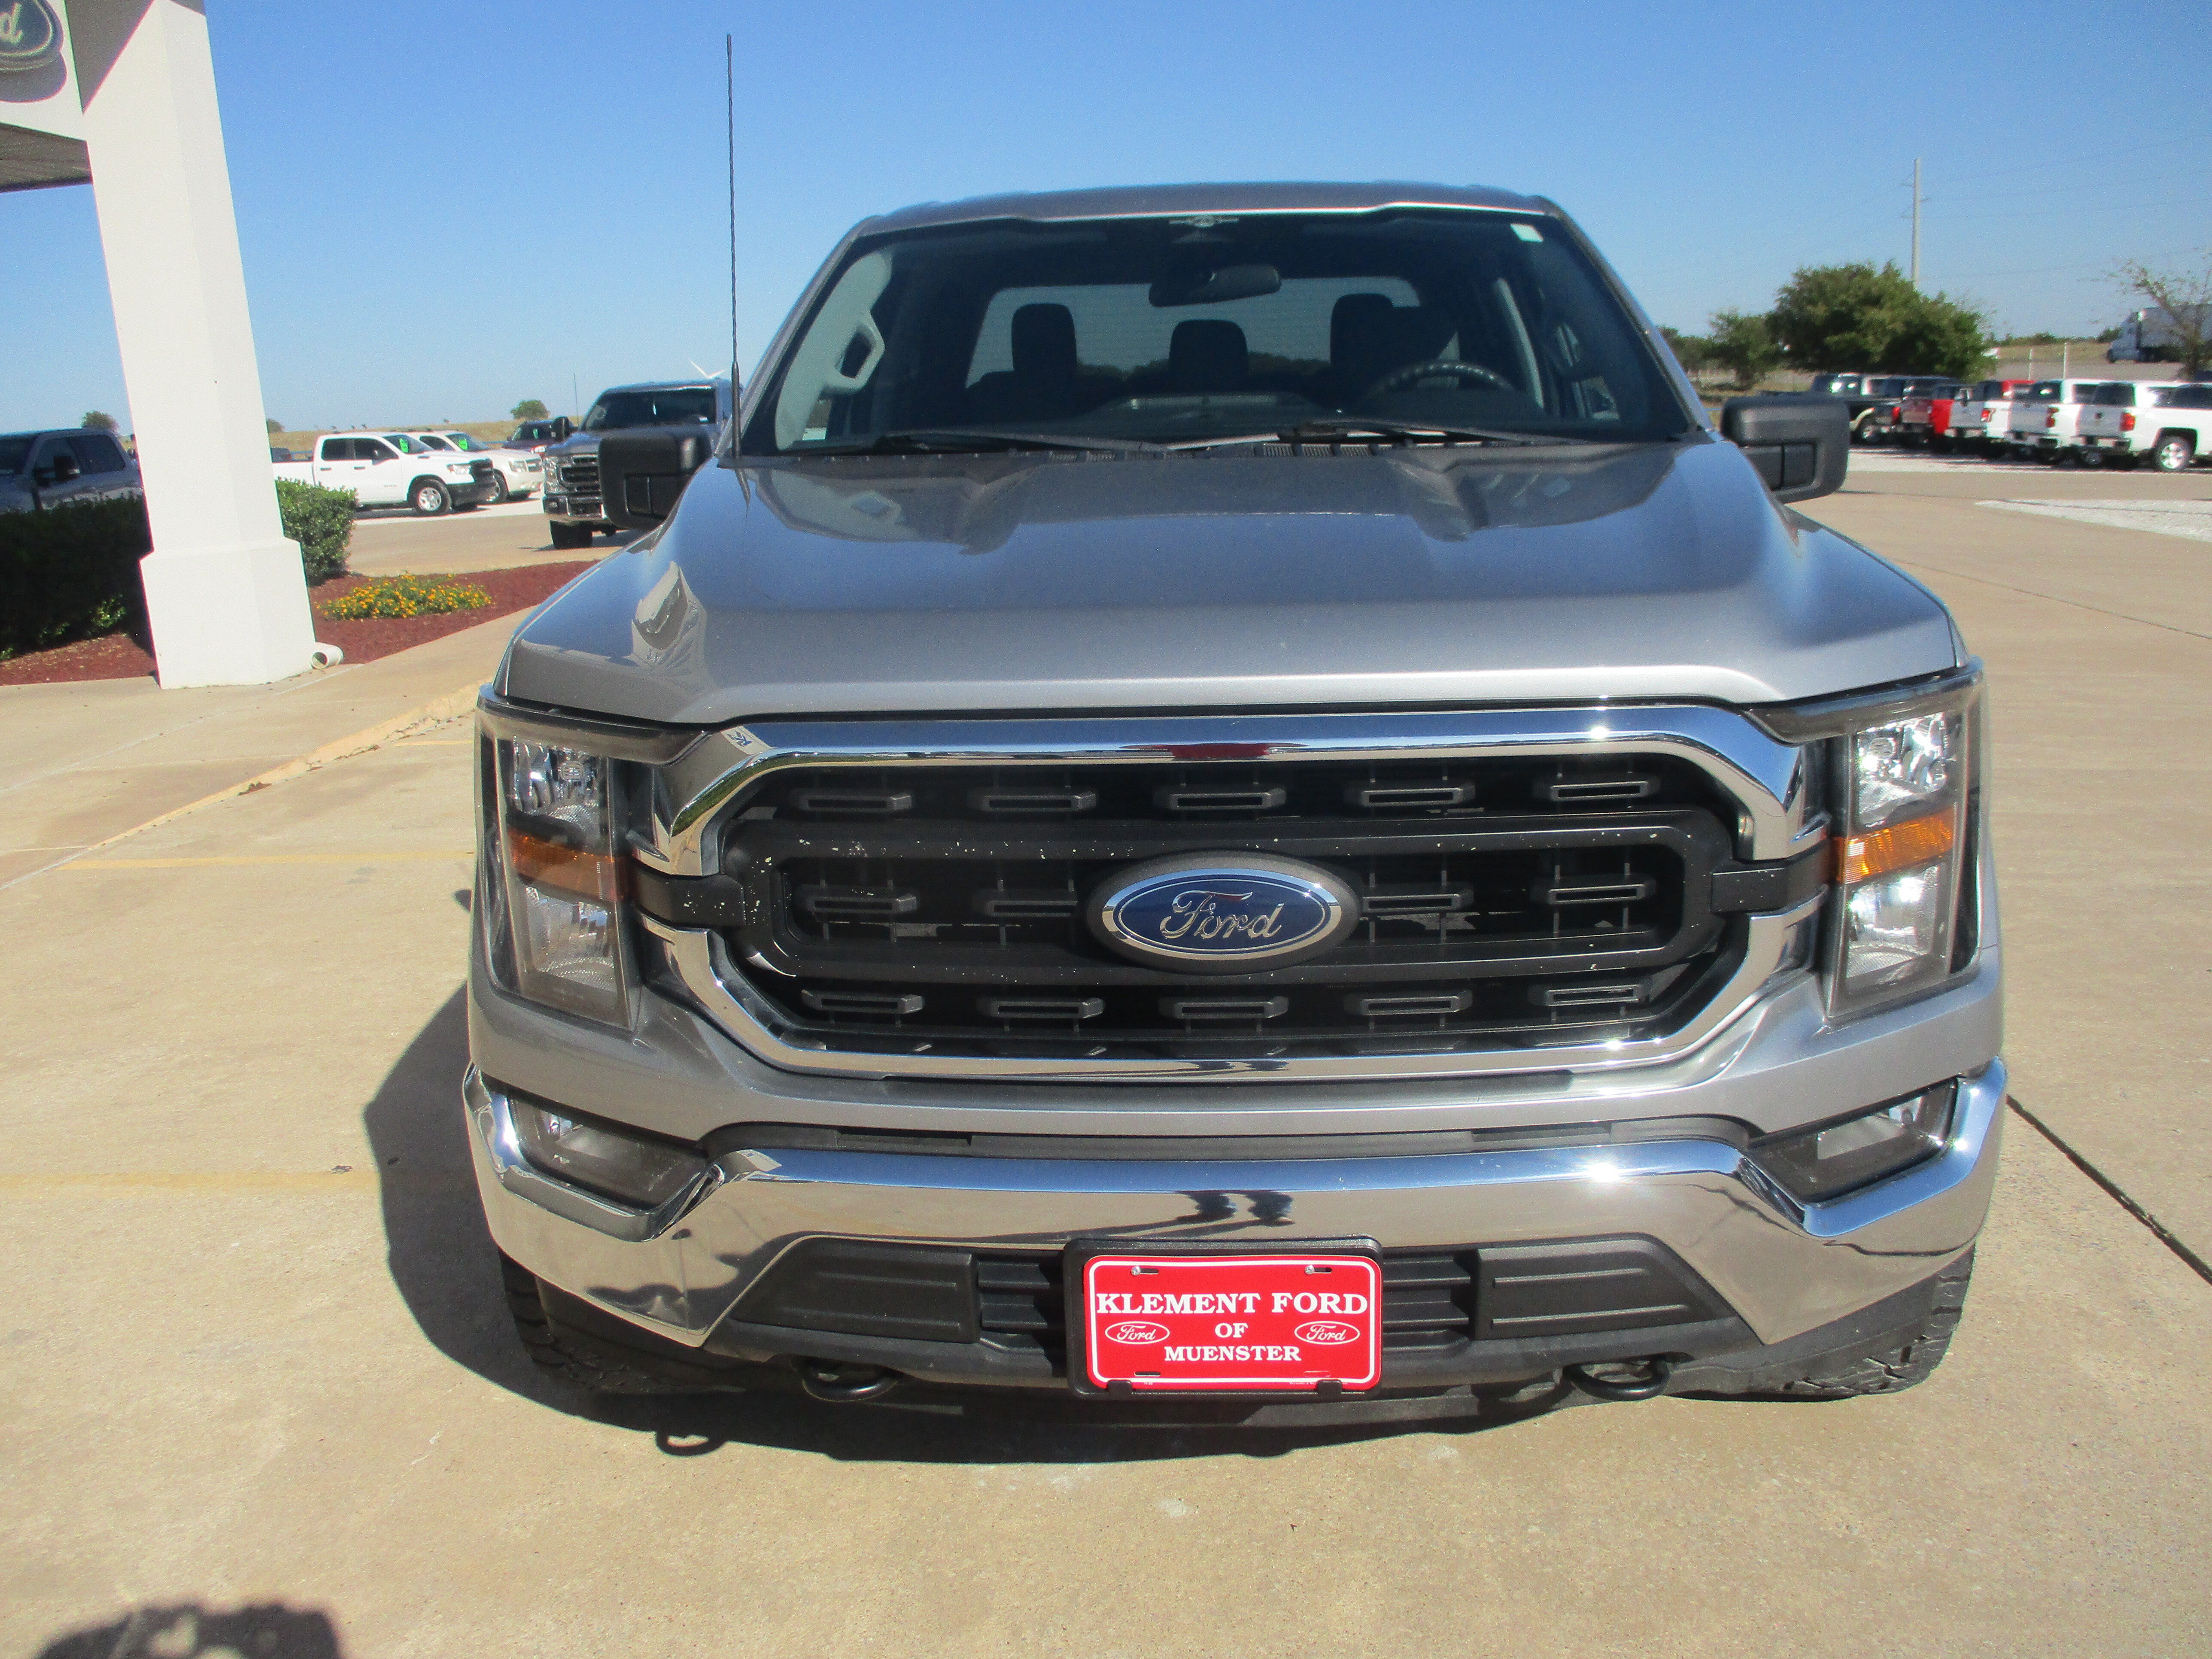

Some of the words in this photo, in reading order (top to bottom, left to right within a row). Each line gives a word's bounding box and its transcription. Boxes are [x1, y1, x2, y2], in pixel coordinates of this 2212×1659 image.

[1159, 890, 1285, 939] Ford
[1097, 1293, 1261, 1314] KLEMENT
[1271, 1292, 1368, 1314] FORD
[1116, 1325, 1156, 1341] Ford
[1215, 1322, 1249, 1338] OF
[1306, 1325, 1346, 1341] Ford
[1164, 1345, 1302, 1361] MUENSTER
